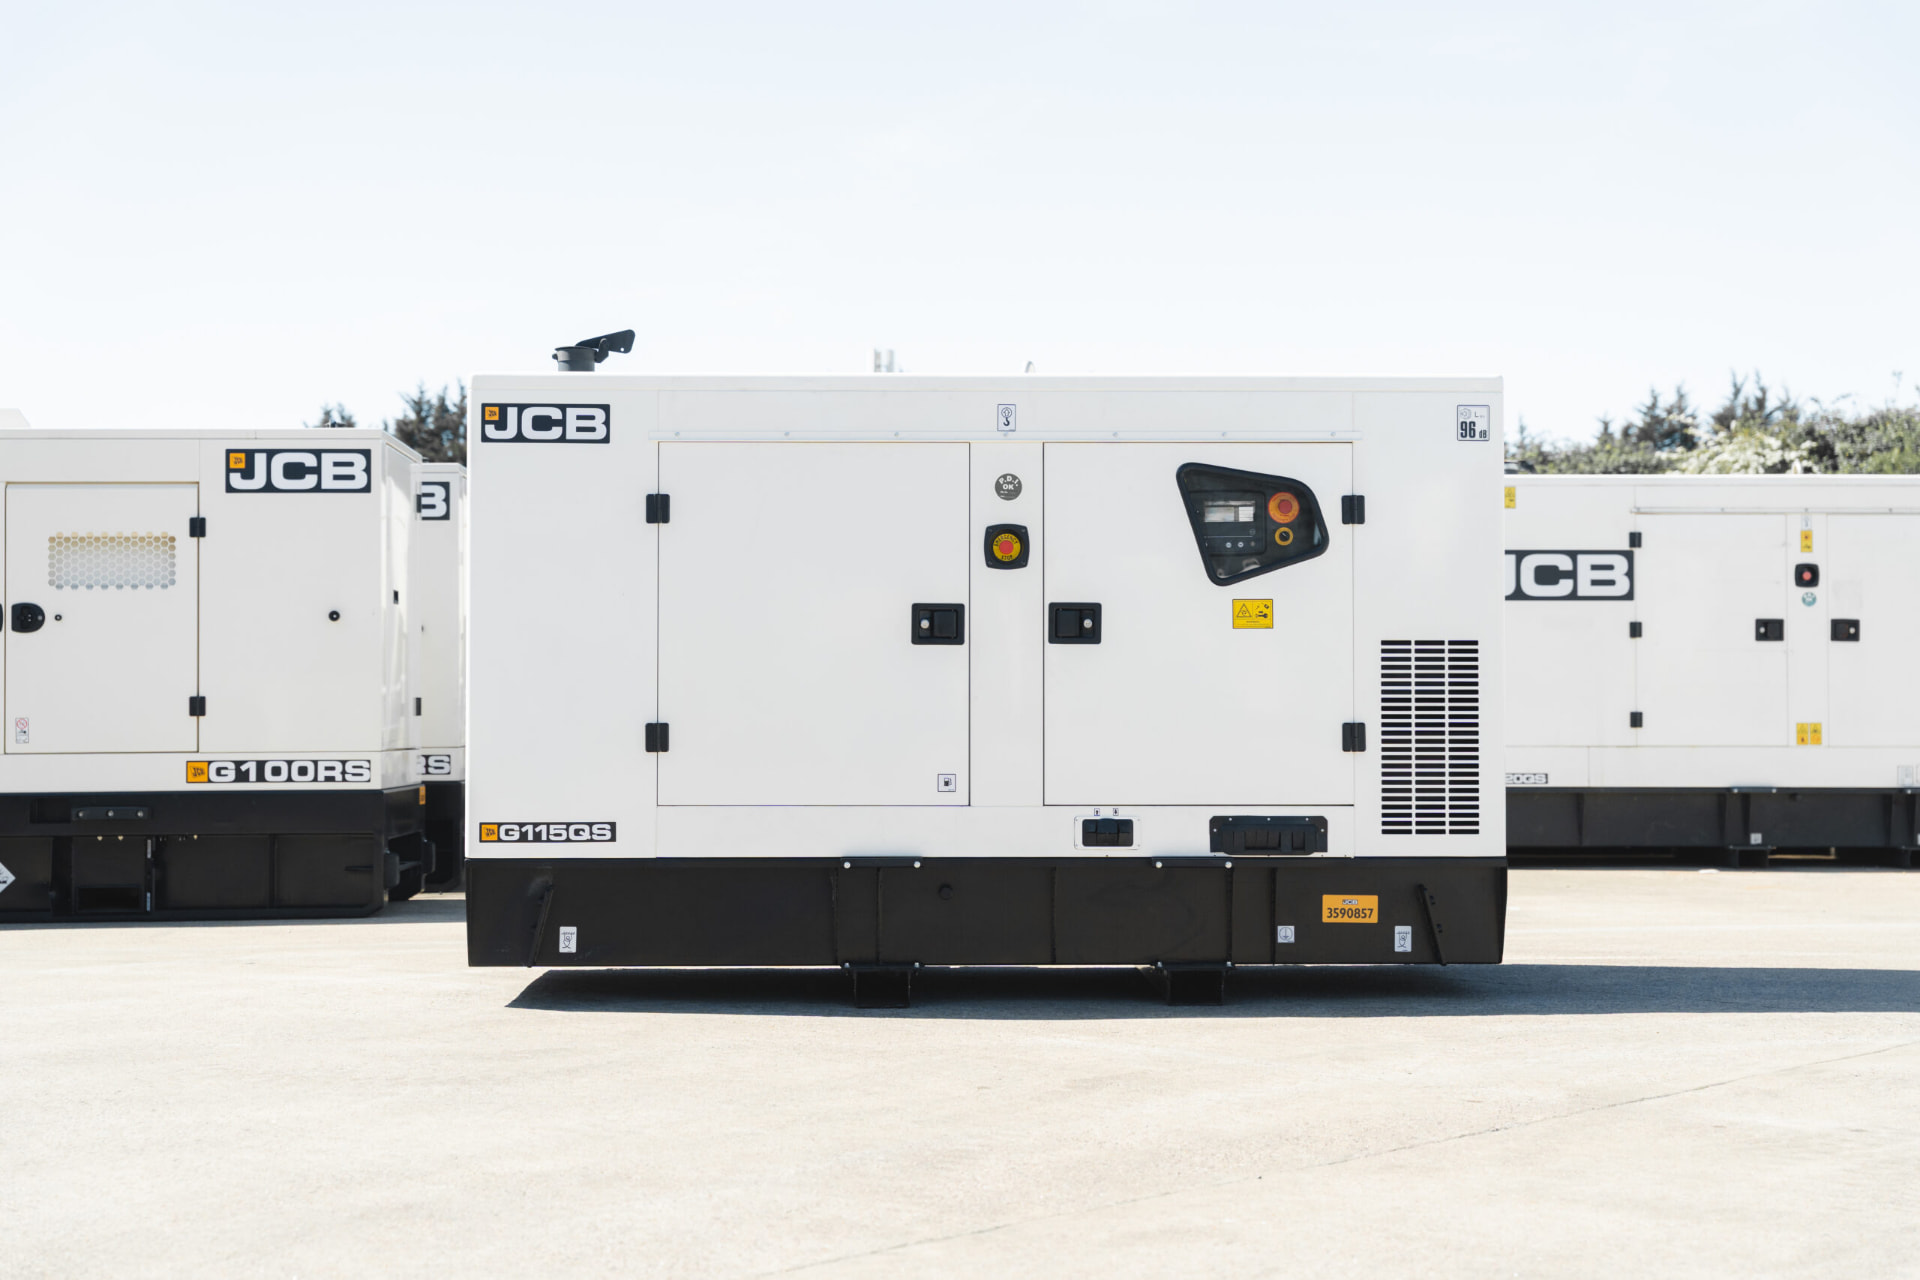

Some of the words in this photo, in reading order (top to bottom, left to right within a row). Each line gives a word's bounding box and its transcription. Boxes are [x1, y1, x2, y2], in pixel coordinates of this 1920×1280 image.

[485, 406, 607, 440] JCB
[1460, 421, 1476, 438] 96
[1479, 429, 1487, 439] dB
[229, 452, 368, 490] JCB
[1505, 553, 1631, 597] CB
[208, 760, 371, 783] G100RS
[499, 824, 612, 841] G115QS
[1327, 907, 1374, 919] 3590857
